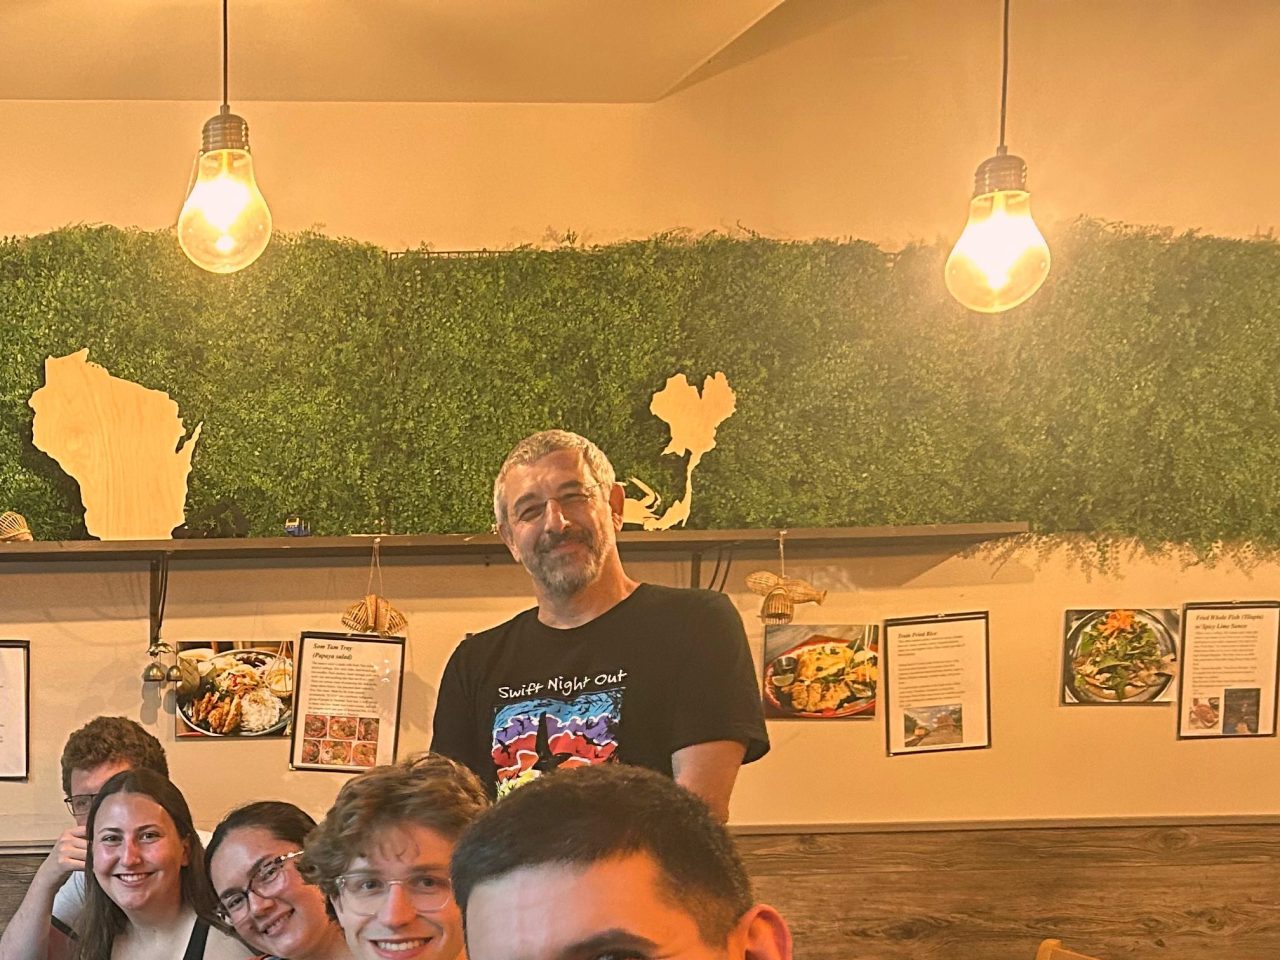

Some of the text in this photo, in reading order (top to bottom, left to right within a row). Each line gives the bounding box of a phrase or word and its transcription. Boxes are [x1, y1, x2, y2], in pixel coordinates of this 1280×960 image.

[340, 644, 353, 652] Tray
[312, 652, 353, 661] (Papaya salad)
[498, 669, 628, 699] Swift Night Out
